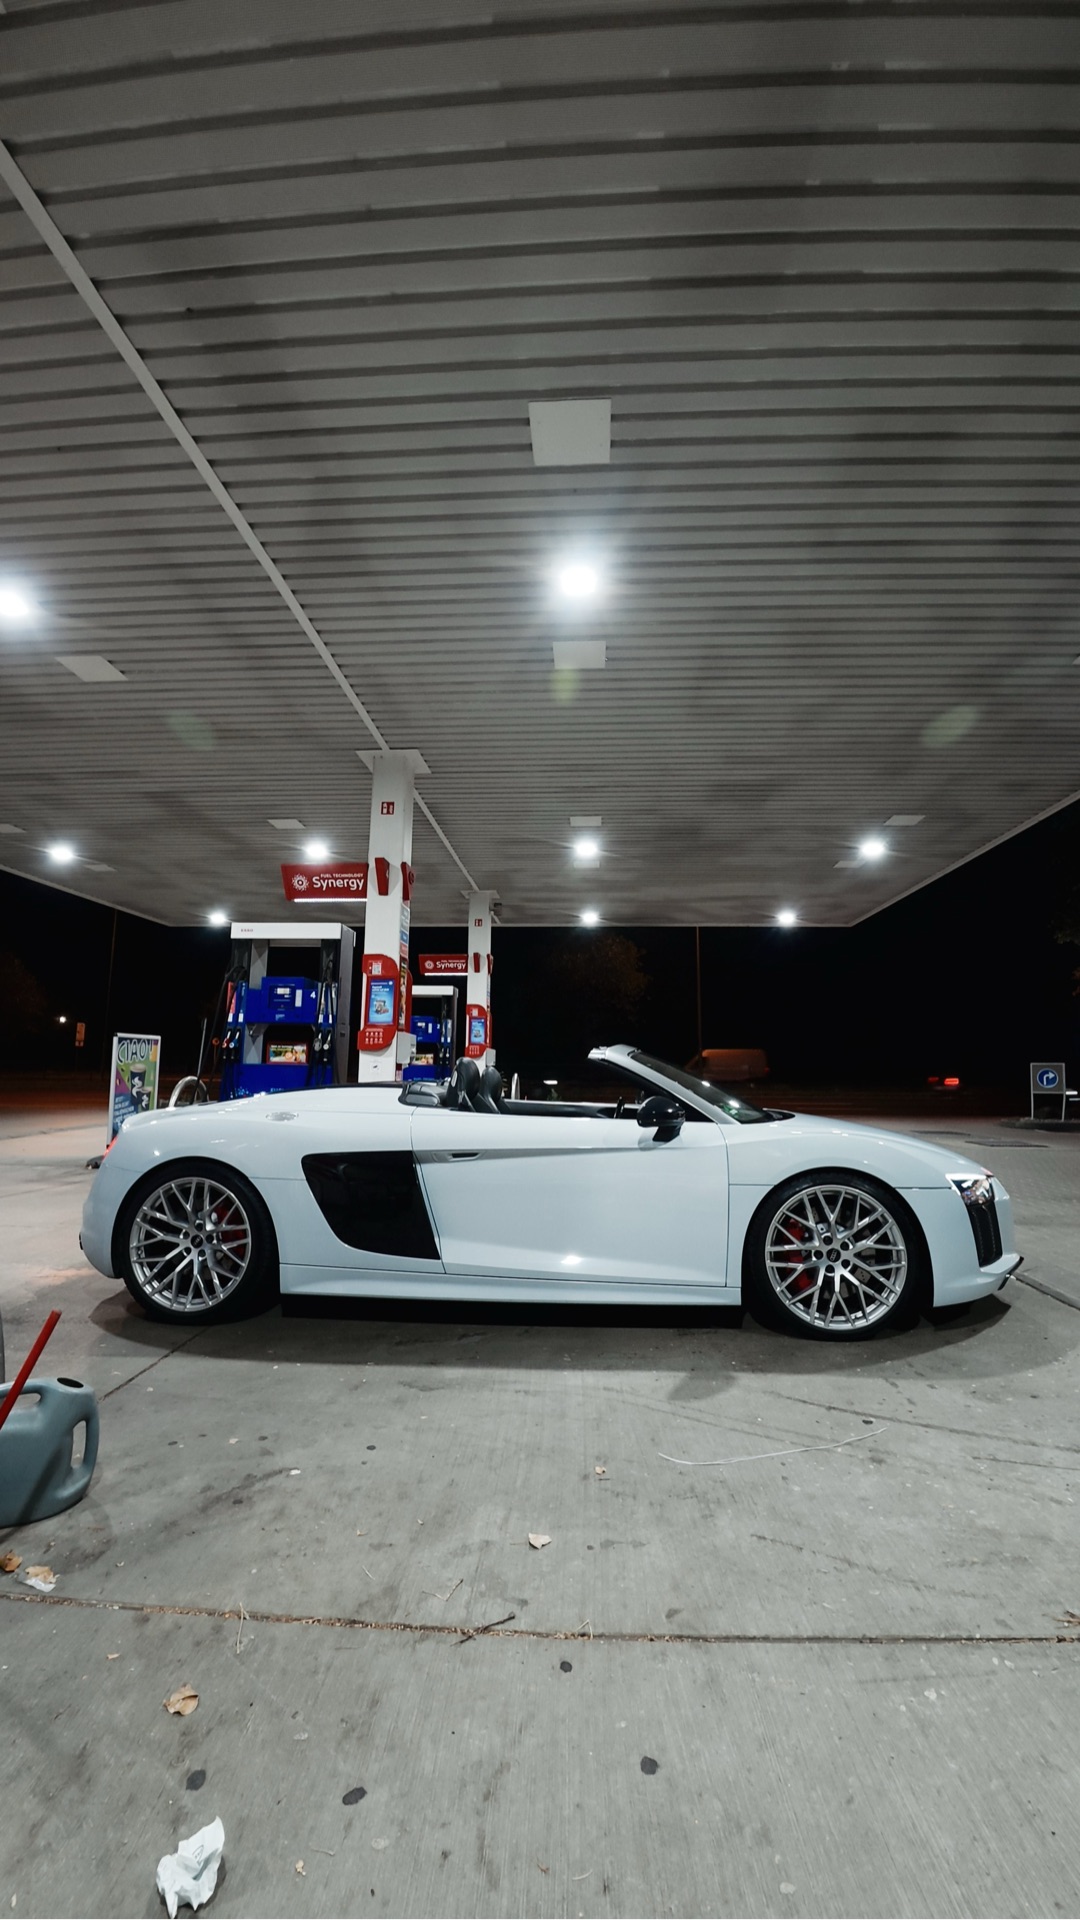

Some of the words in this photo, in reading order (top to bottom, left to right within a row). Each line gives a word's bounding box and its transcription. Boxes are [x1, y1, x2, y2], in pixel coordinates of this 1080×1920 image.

[312, 876, 364, 891] Synergy
[436, 961, 466, 970] Synergy
[310, 991, 316, 999] 4
